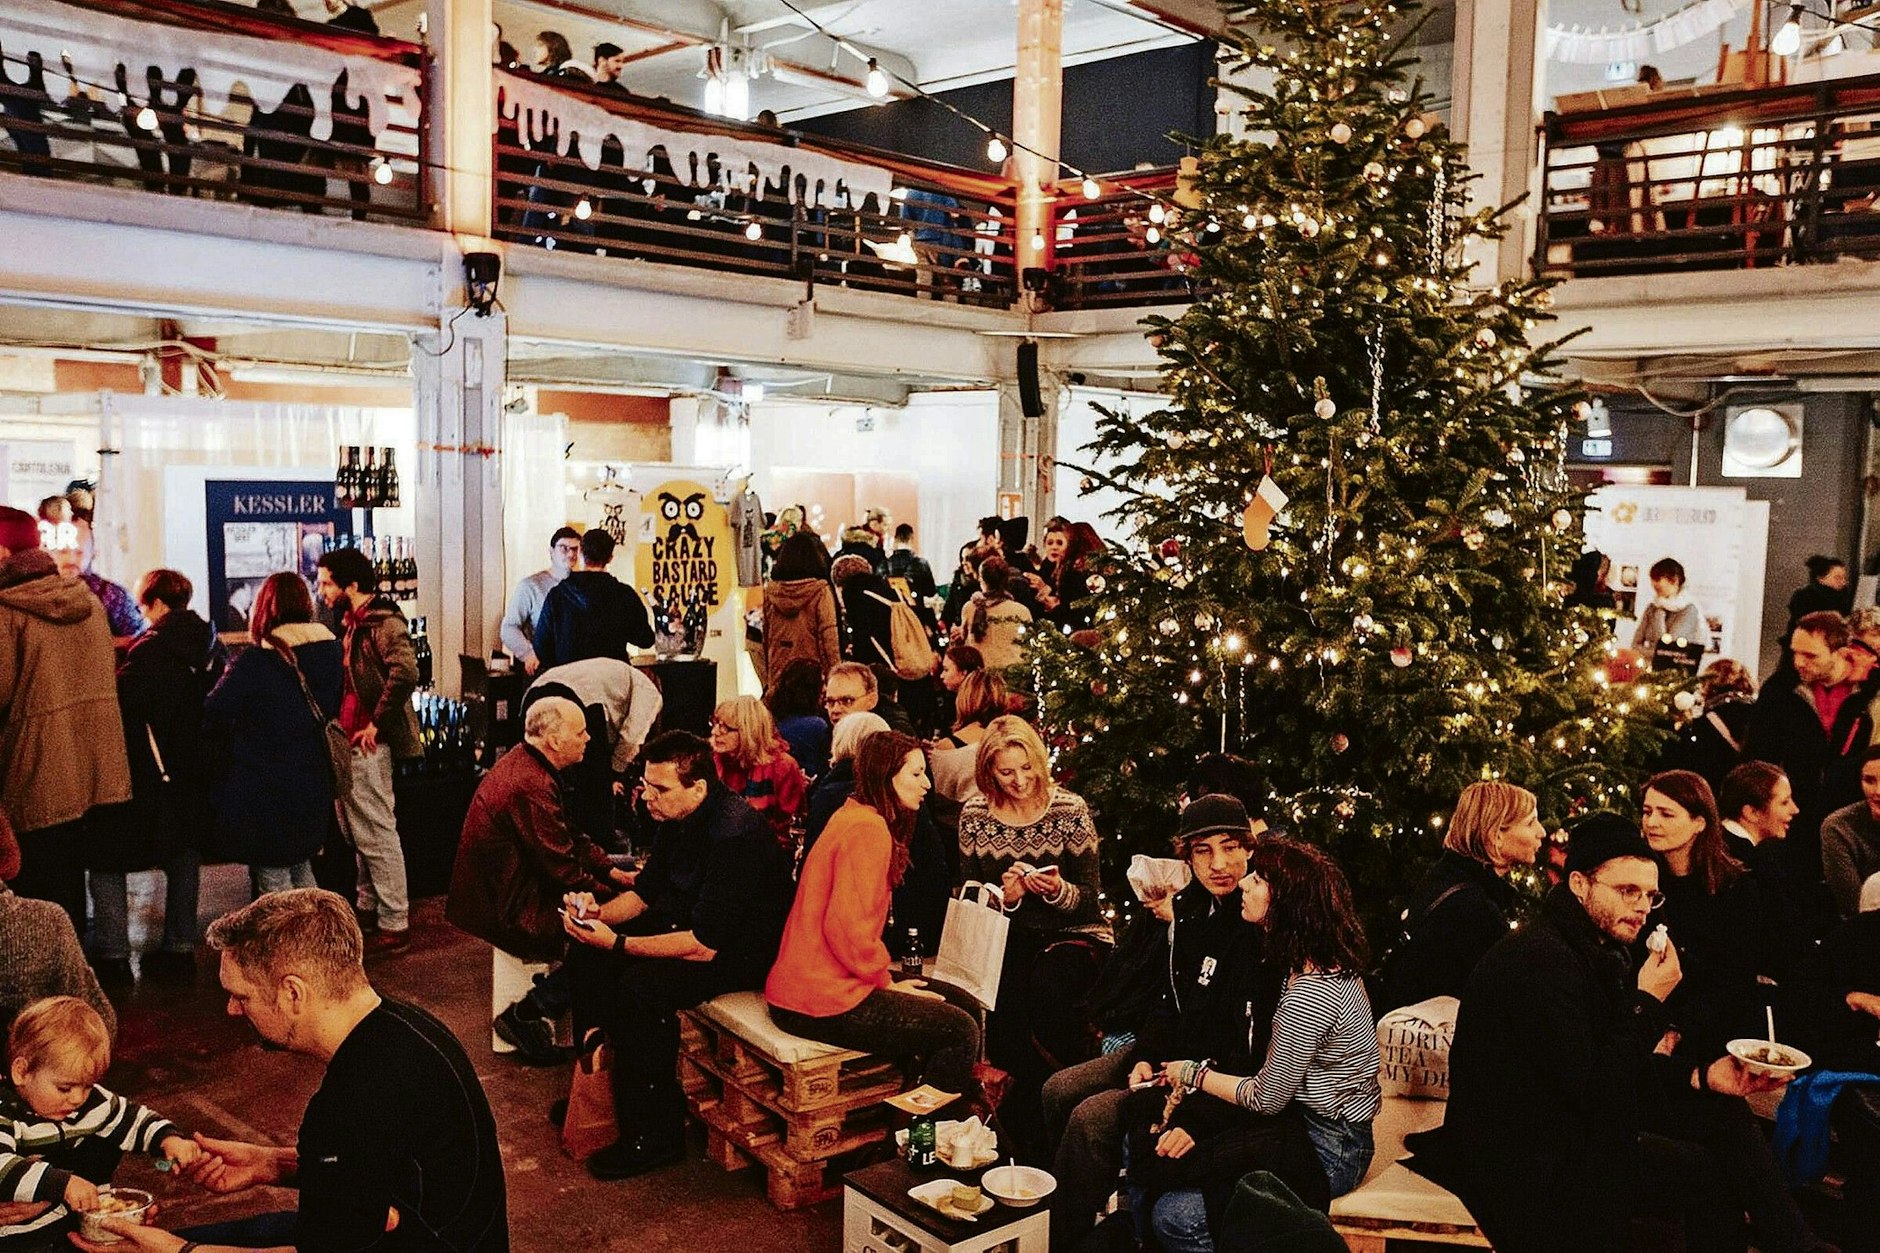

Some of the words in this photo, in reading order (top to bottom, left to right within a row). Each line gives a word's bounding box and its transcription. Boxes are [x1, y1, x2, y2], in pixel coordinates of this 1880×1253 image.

[234, 494, 325, 514] KESSLER
[652, 536, 715, 560] CRAZY
[652, 560, 717, 584] BASTARD
[653, 582, 719, 607] SAUCE
[1385, 1045, 1426, 1067] TEA
